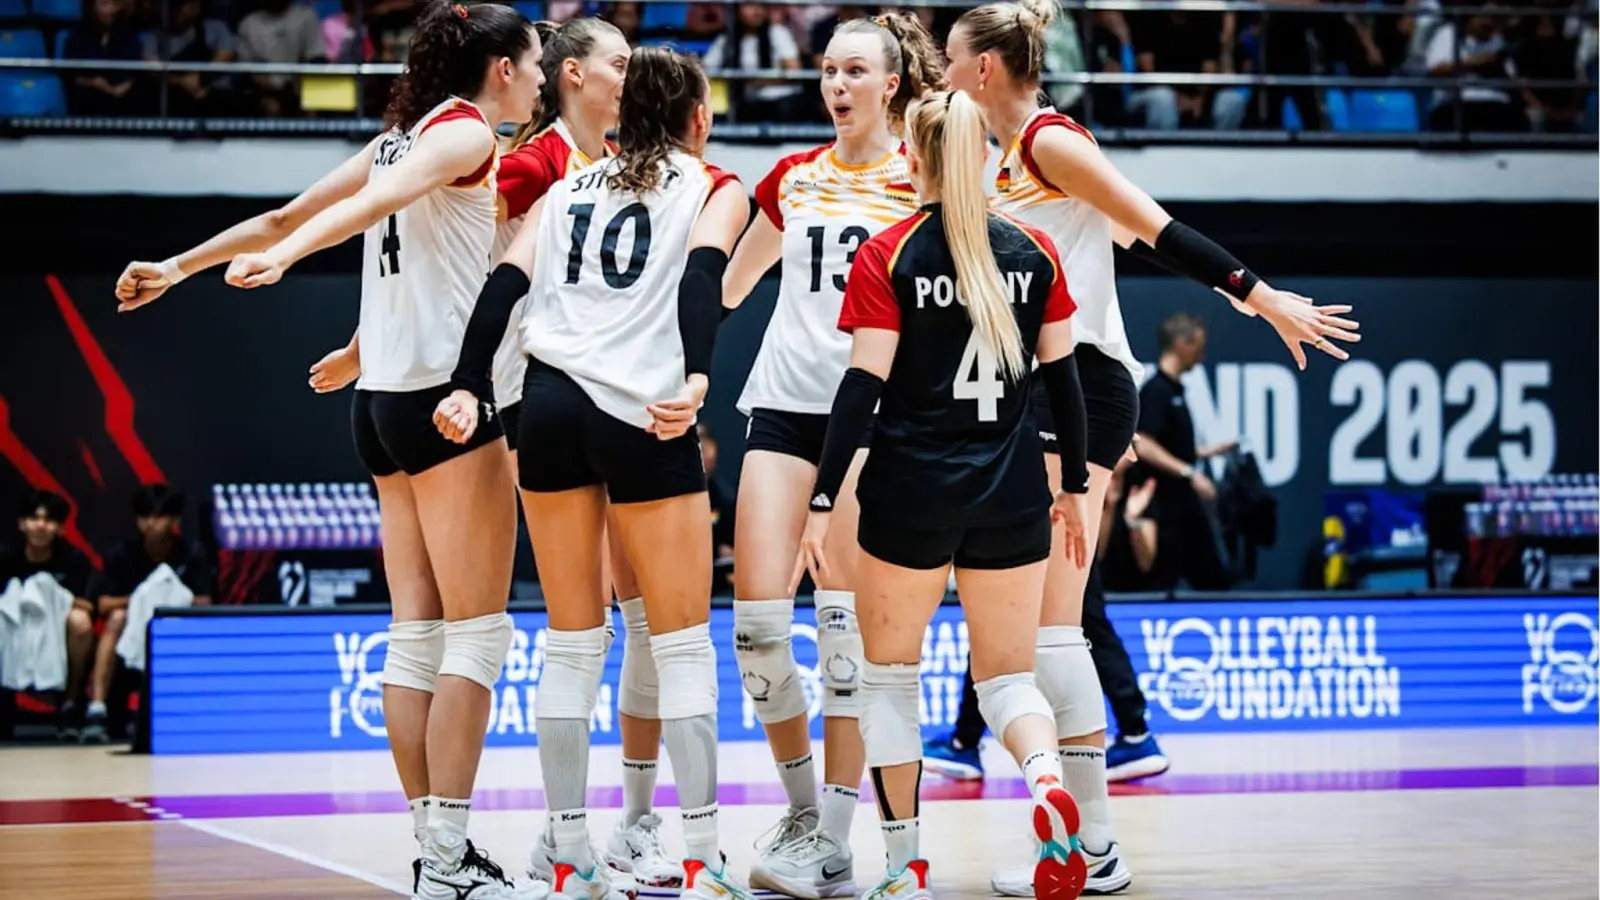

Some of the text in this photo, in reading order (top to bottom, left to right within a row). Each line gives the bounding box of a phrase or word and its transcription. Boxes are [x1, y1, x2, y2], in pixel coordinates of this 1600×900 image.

[571, 167, 680, 193] STIT
[564, 202, 652, 290] 10
[806, 225, 870, 293] 13
[952, 325, 1005, 422] 4
[1328, 359, 1557, 485] 2025
[1140, 614, 1387, 673] VOLLEYBALL
[1138, 665, 1401, 722] FOUNDATION
